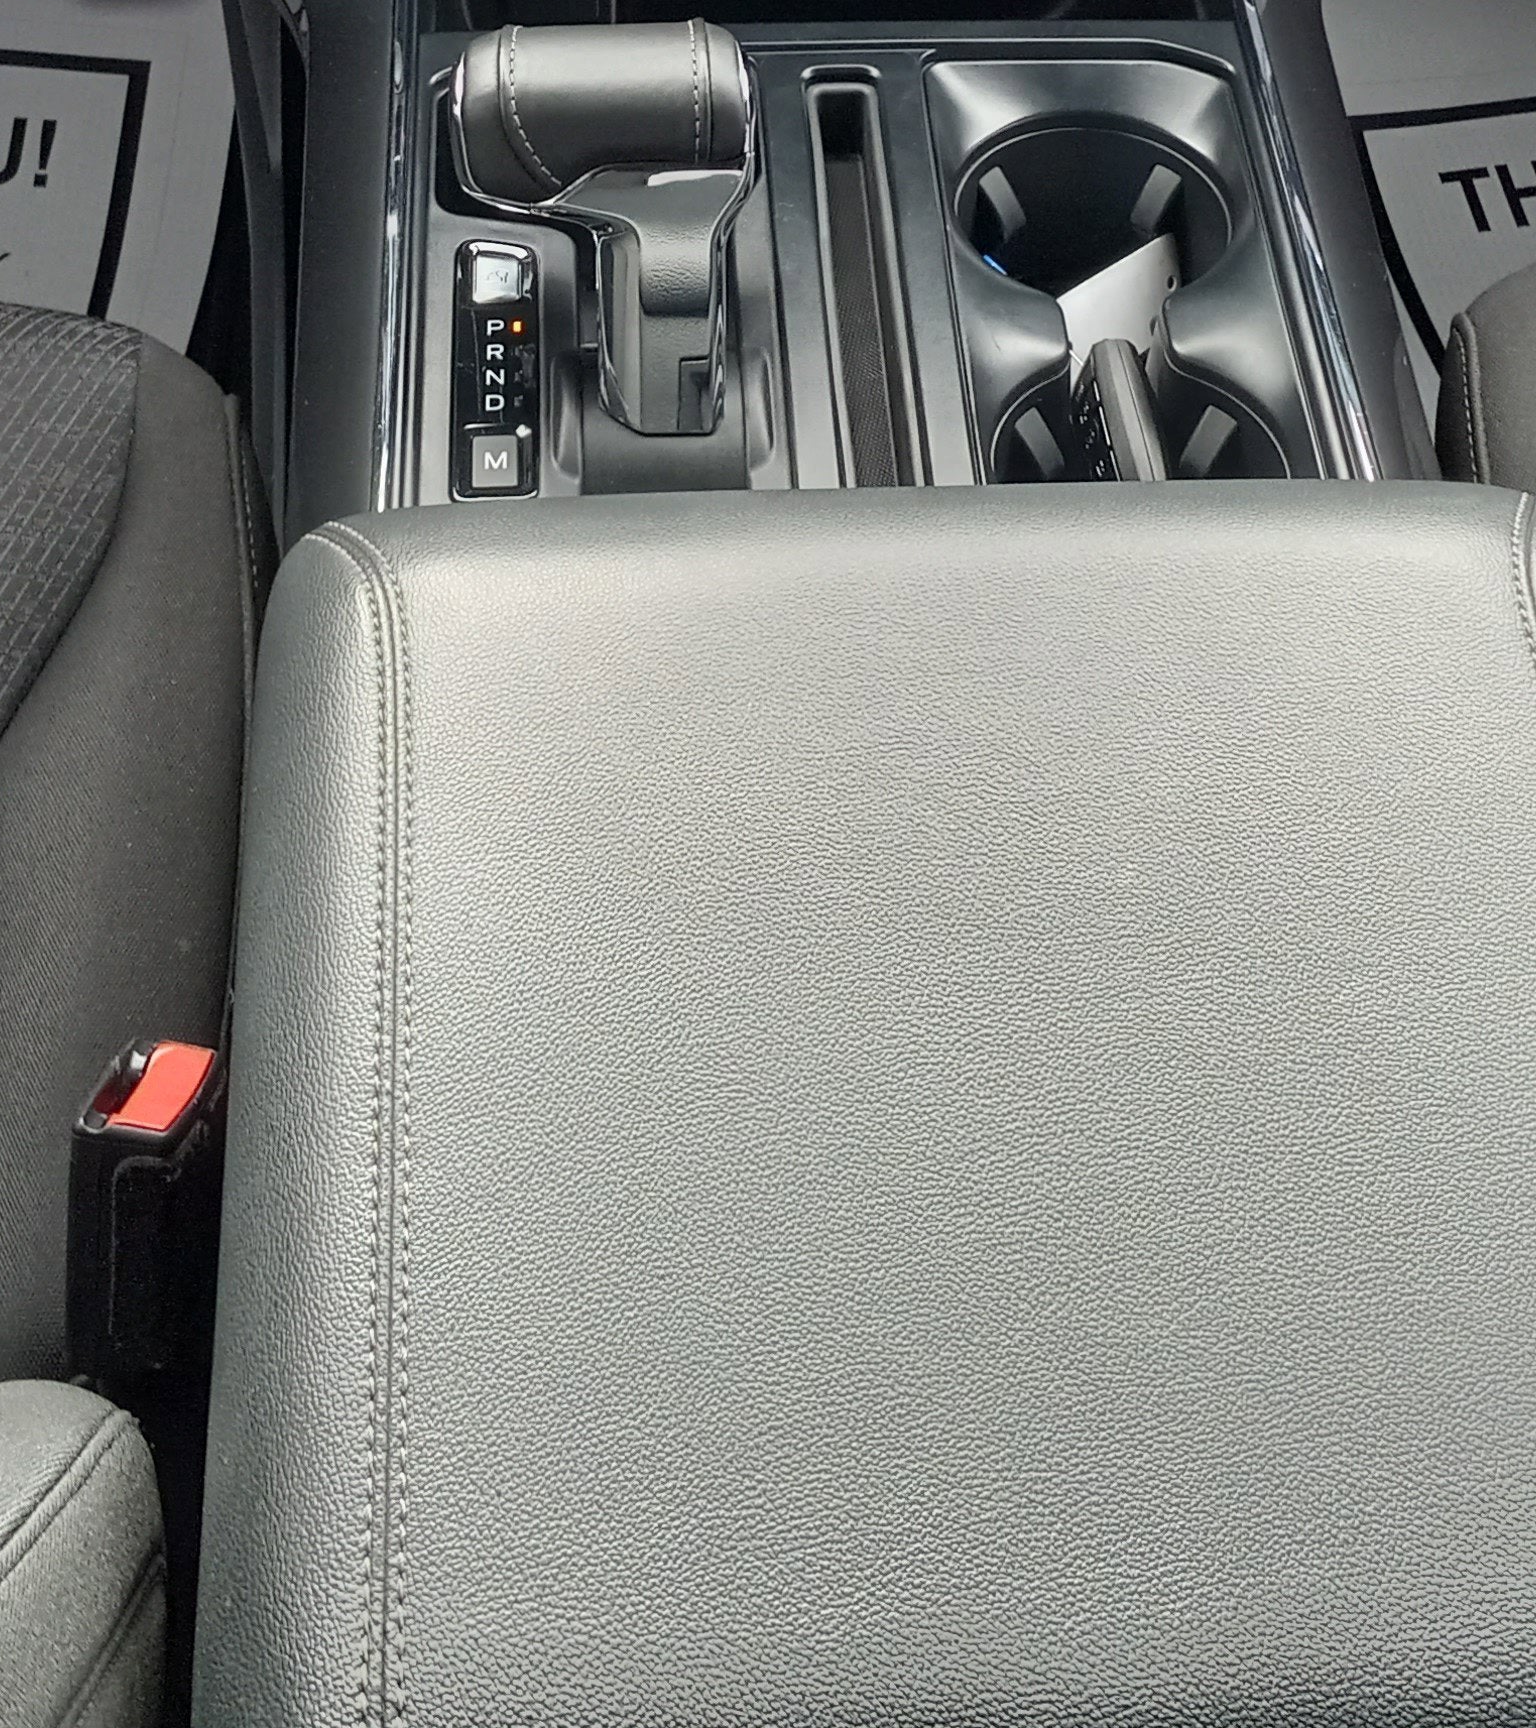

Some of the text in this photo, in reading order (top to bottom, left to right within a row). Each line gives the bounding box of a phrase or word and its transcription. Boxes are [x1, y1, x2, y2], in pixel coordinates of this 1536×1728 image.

[486, 319, 505, 336] P
[486, 344, 504, 361] R
[485, 369, 505, 386] N
[485, 394, 505, 412] D
[483, 451, 508, 469] M
